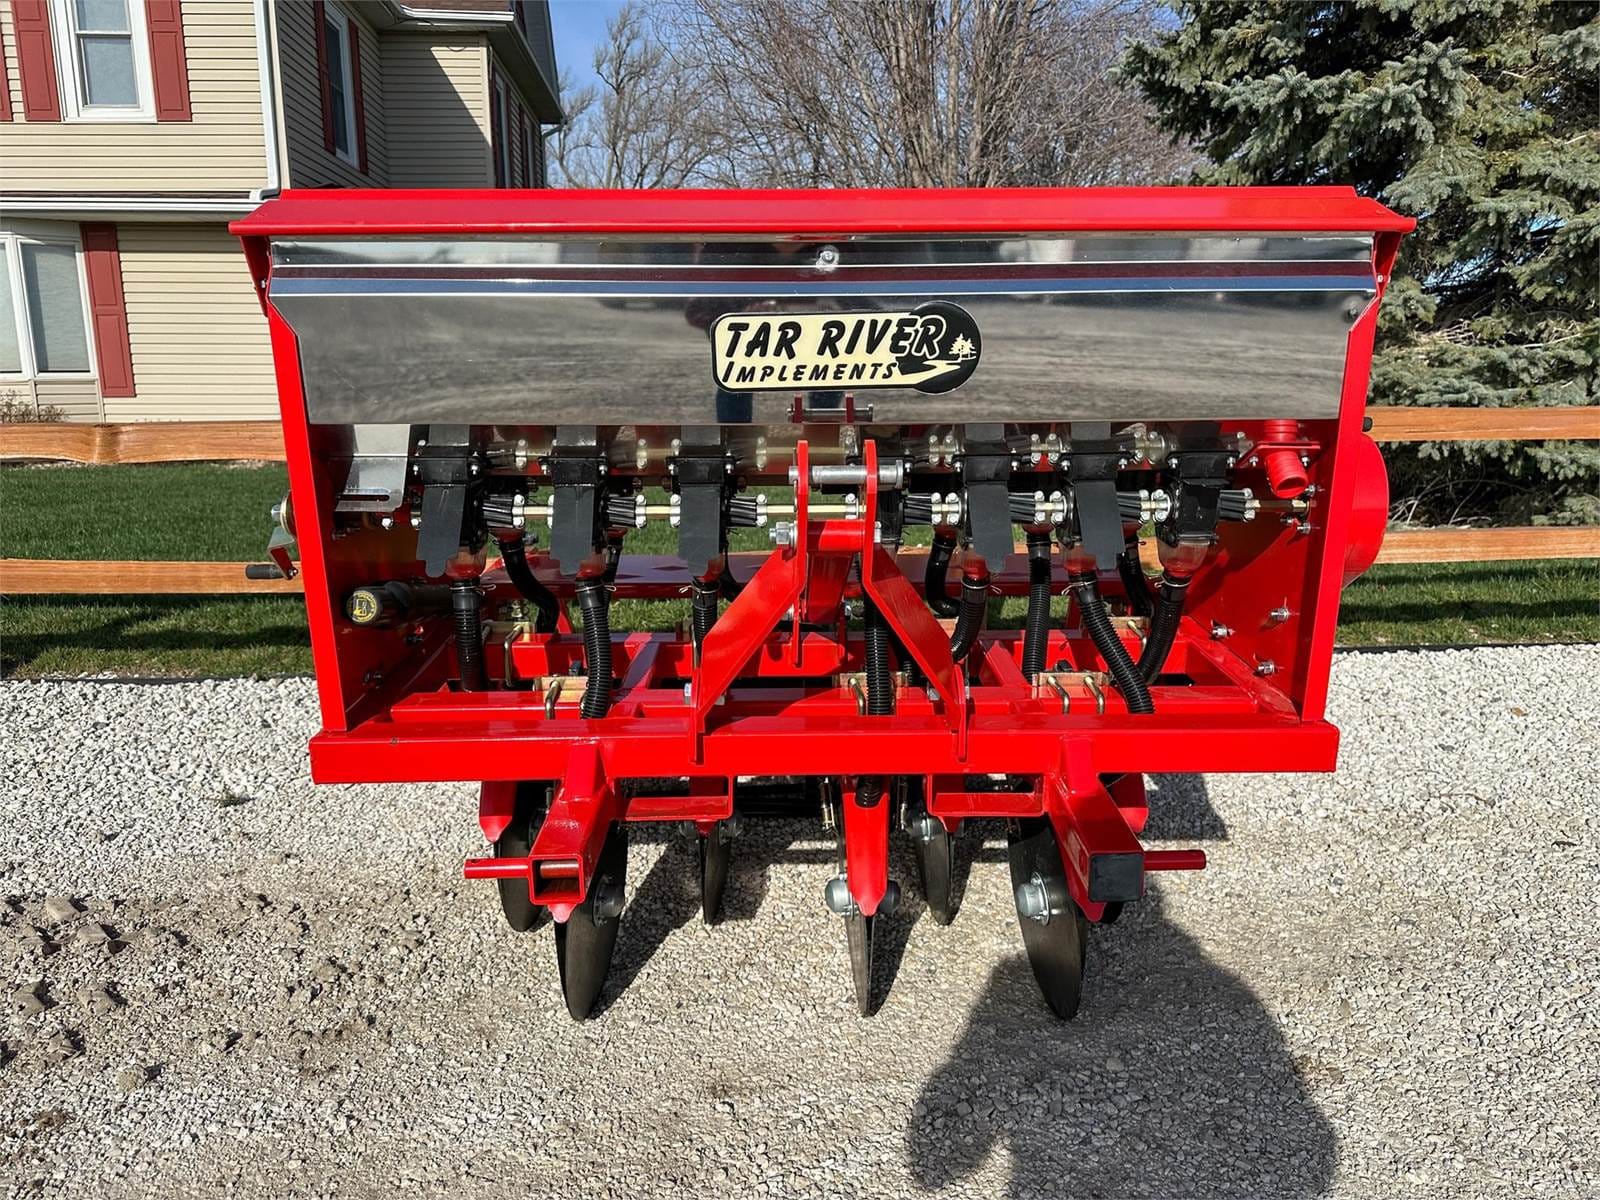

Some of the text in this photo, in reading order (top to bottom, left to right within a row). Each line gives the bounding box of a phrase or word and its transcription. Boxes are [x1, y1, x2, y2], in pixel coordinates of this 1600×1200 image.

[725, 315, 947, 360] TAR RIVER
[721, 361, 898, 383] IMPLEMENTS
